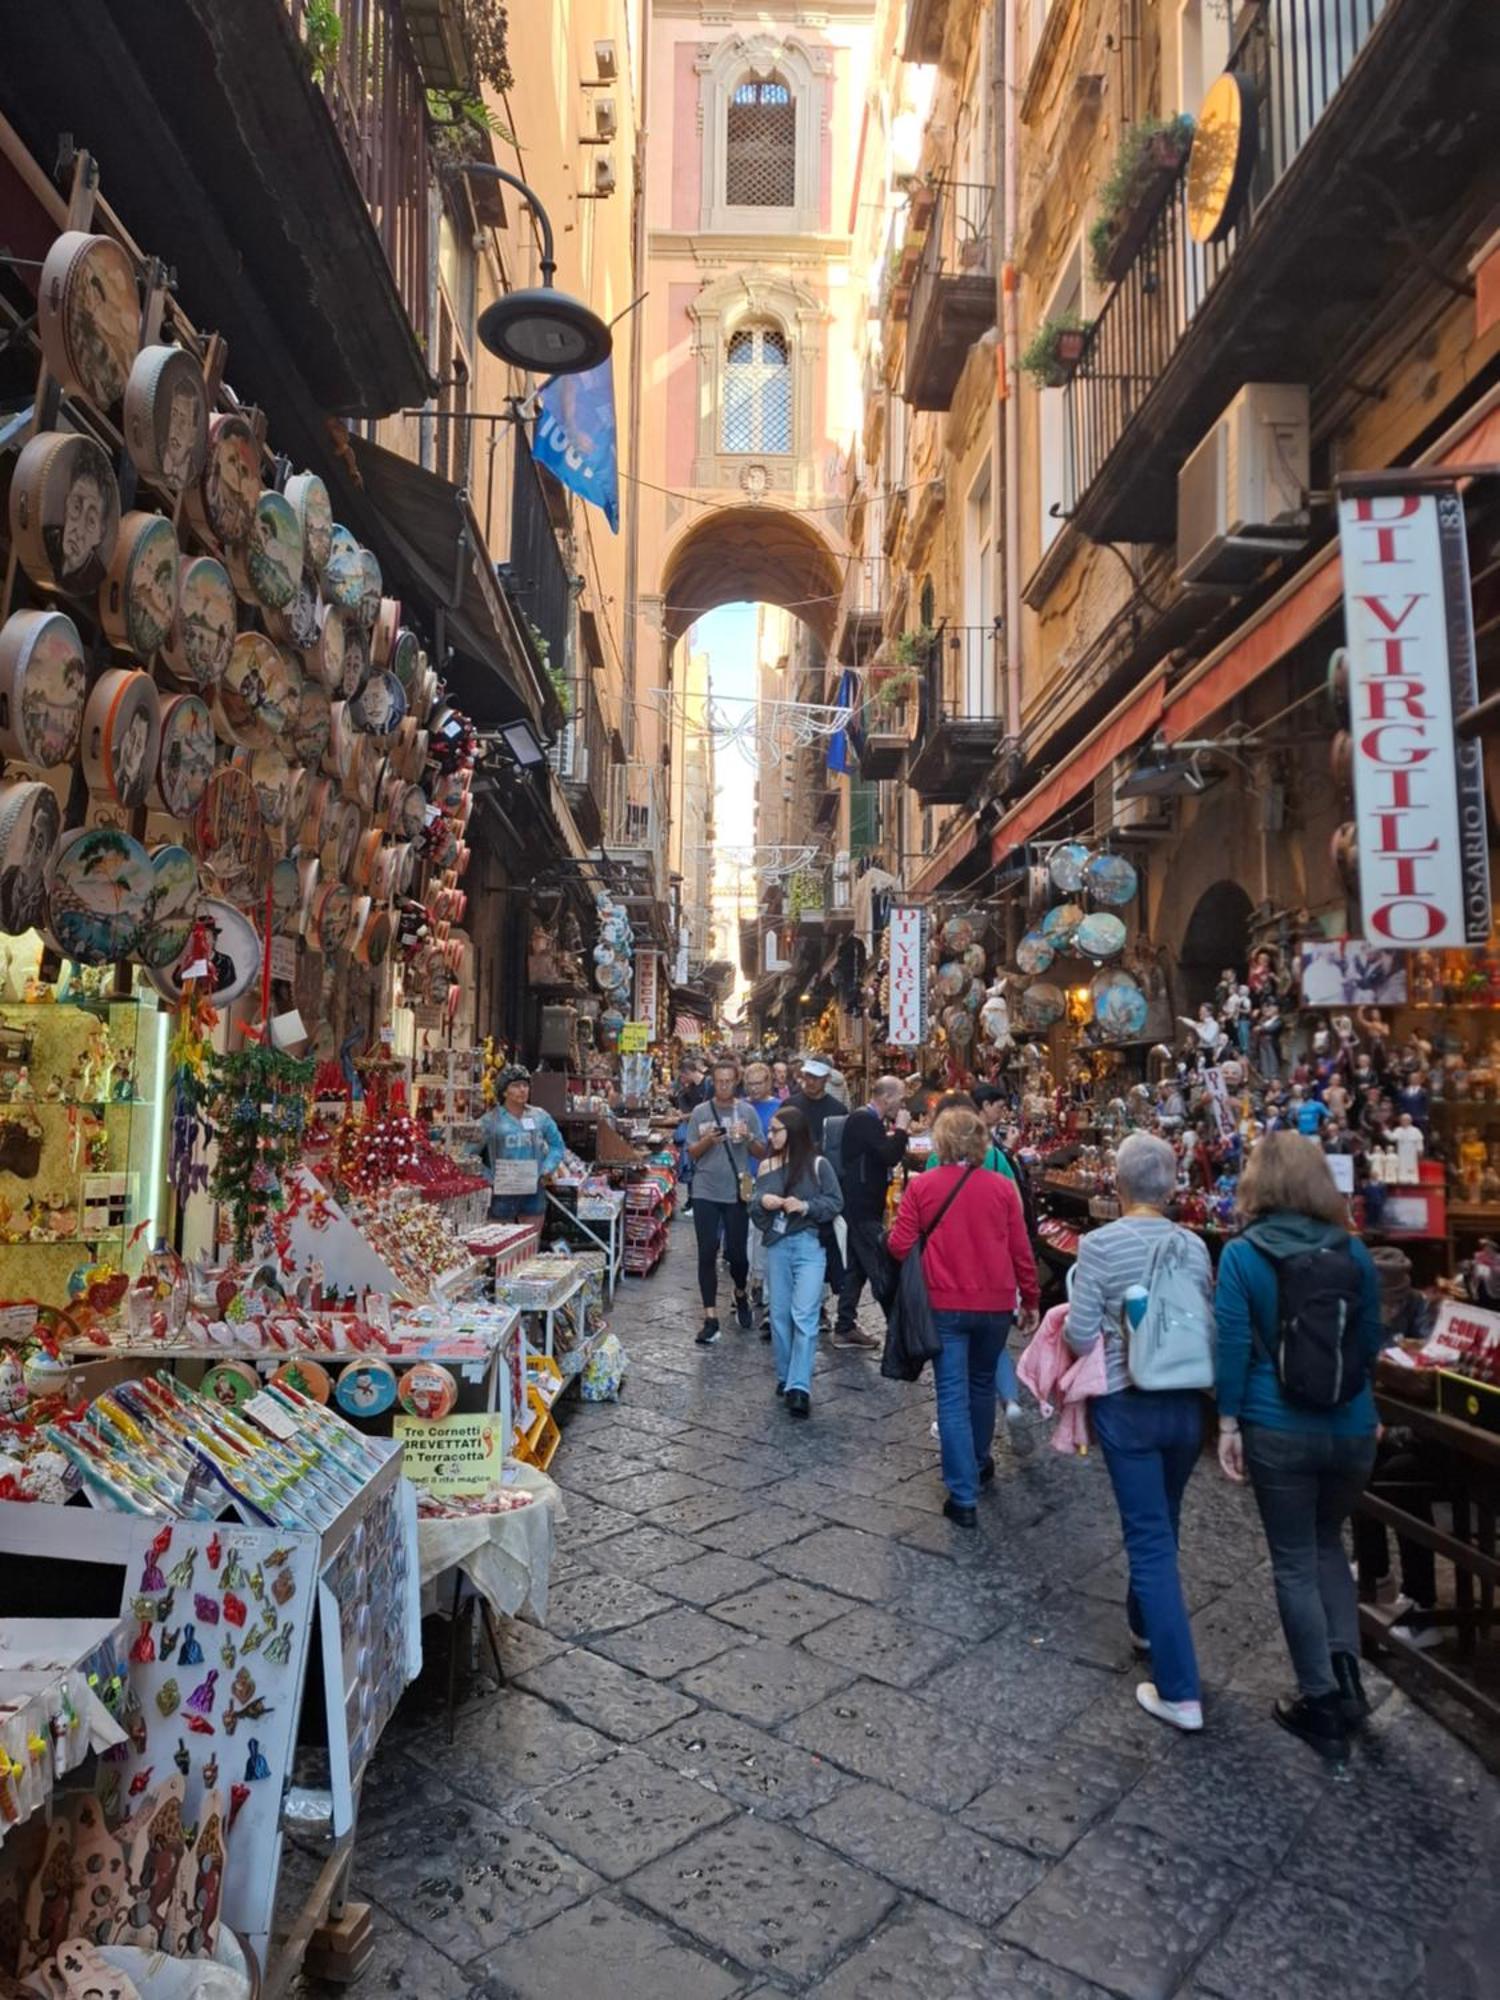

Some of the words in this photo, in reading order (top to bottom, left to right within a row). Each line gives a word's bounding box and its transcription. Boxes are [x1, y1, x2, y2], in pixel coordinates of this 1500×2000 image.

[1438, 493, 1463, 539] 183
[1352, 594, 1448, 942] VIRGILIO
[1464, 805, 1491, 938] ROSARIO
[894, 942, 917, 1042] VIRGILIO
[404, 1427, 425, 1437] Tre
[428, 1426, 481, 1437] Cornetti
[417, 1451, 485, 1462] Terracotta
